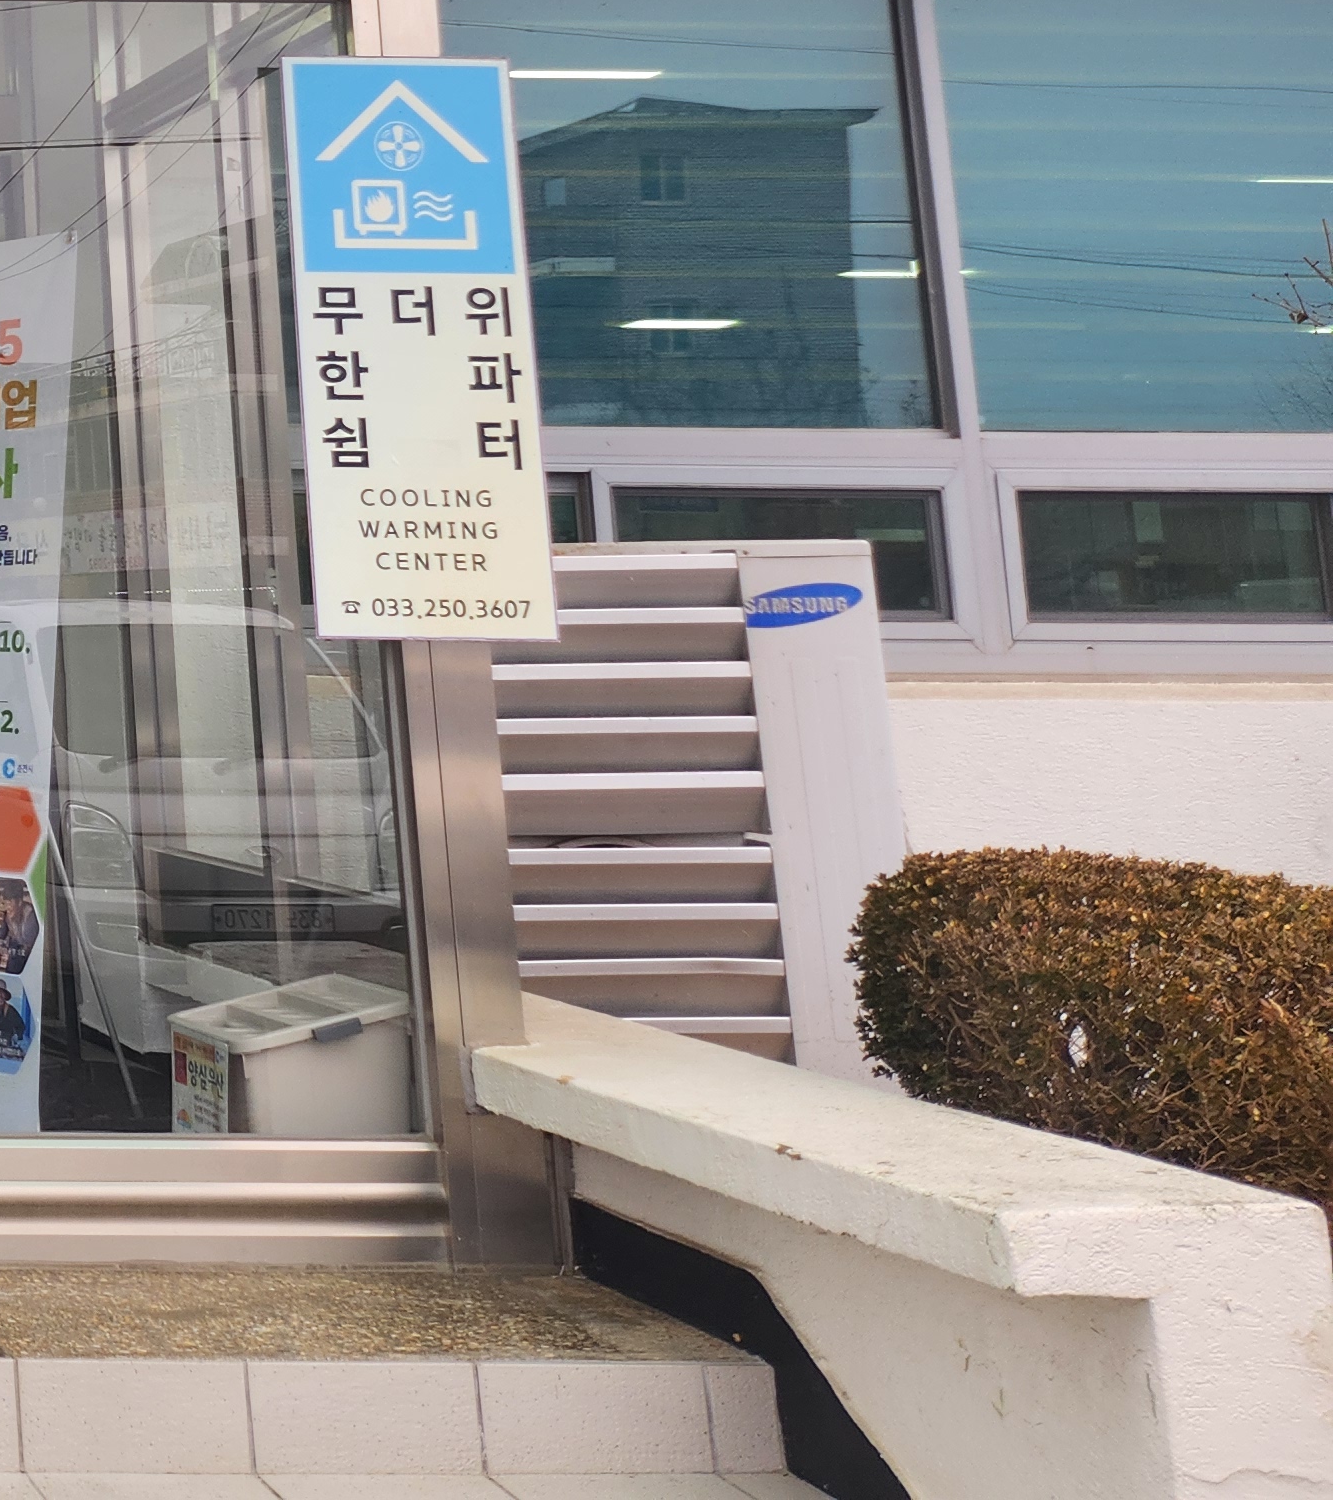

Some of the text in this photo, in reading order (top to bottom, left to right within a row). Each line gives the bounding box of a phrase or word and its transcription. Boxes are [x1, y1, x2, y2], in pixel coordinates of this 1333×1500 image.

[359, 488, 494, 509] COOLING
[358, 519, 500, 540] WARMING
[375, 551, 488, 572] CENTER
[371, 597, 531, 620] 033.250.3607
[743, 596, 848, 615] SAMSUNG
